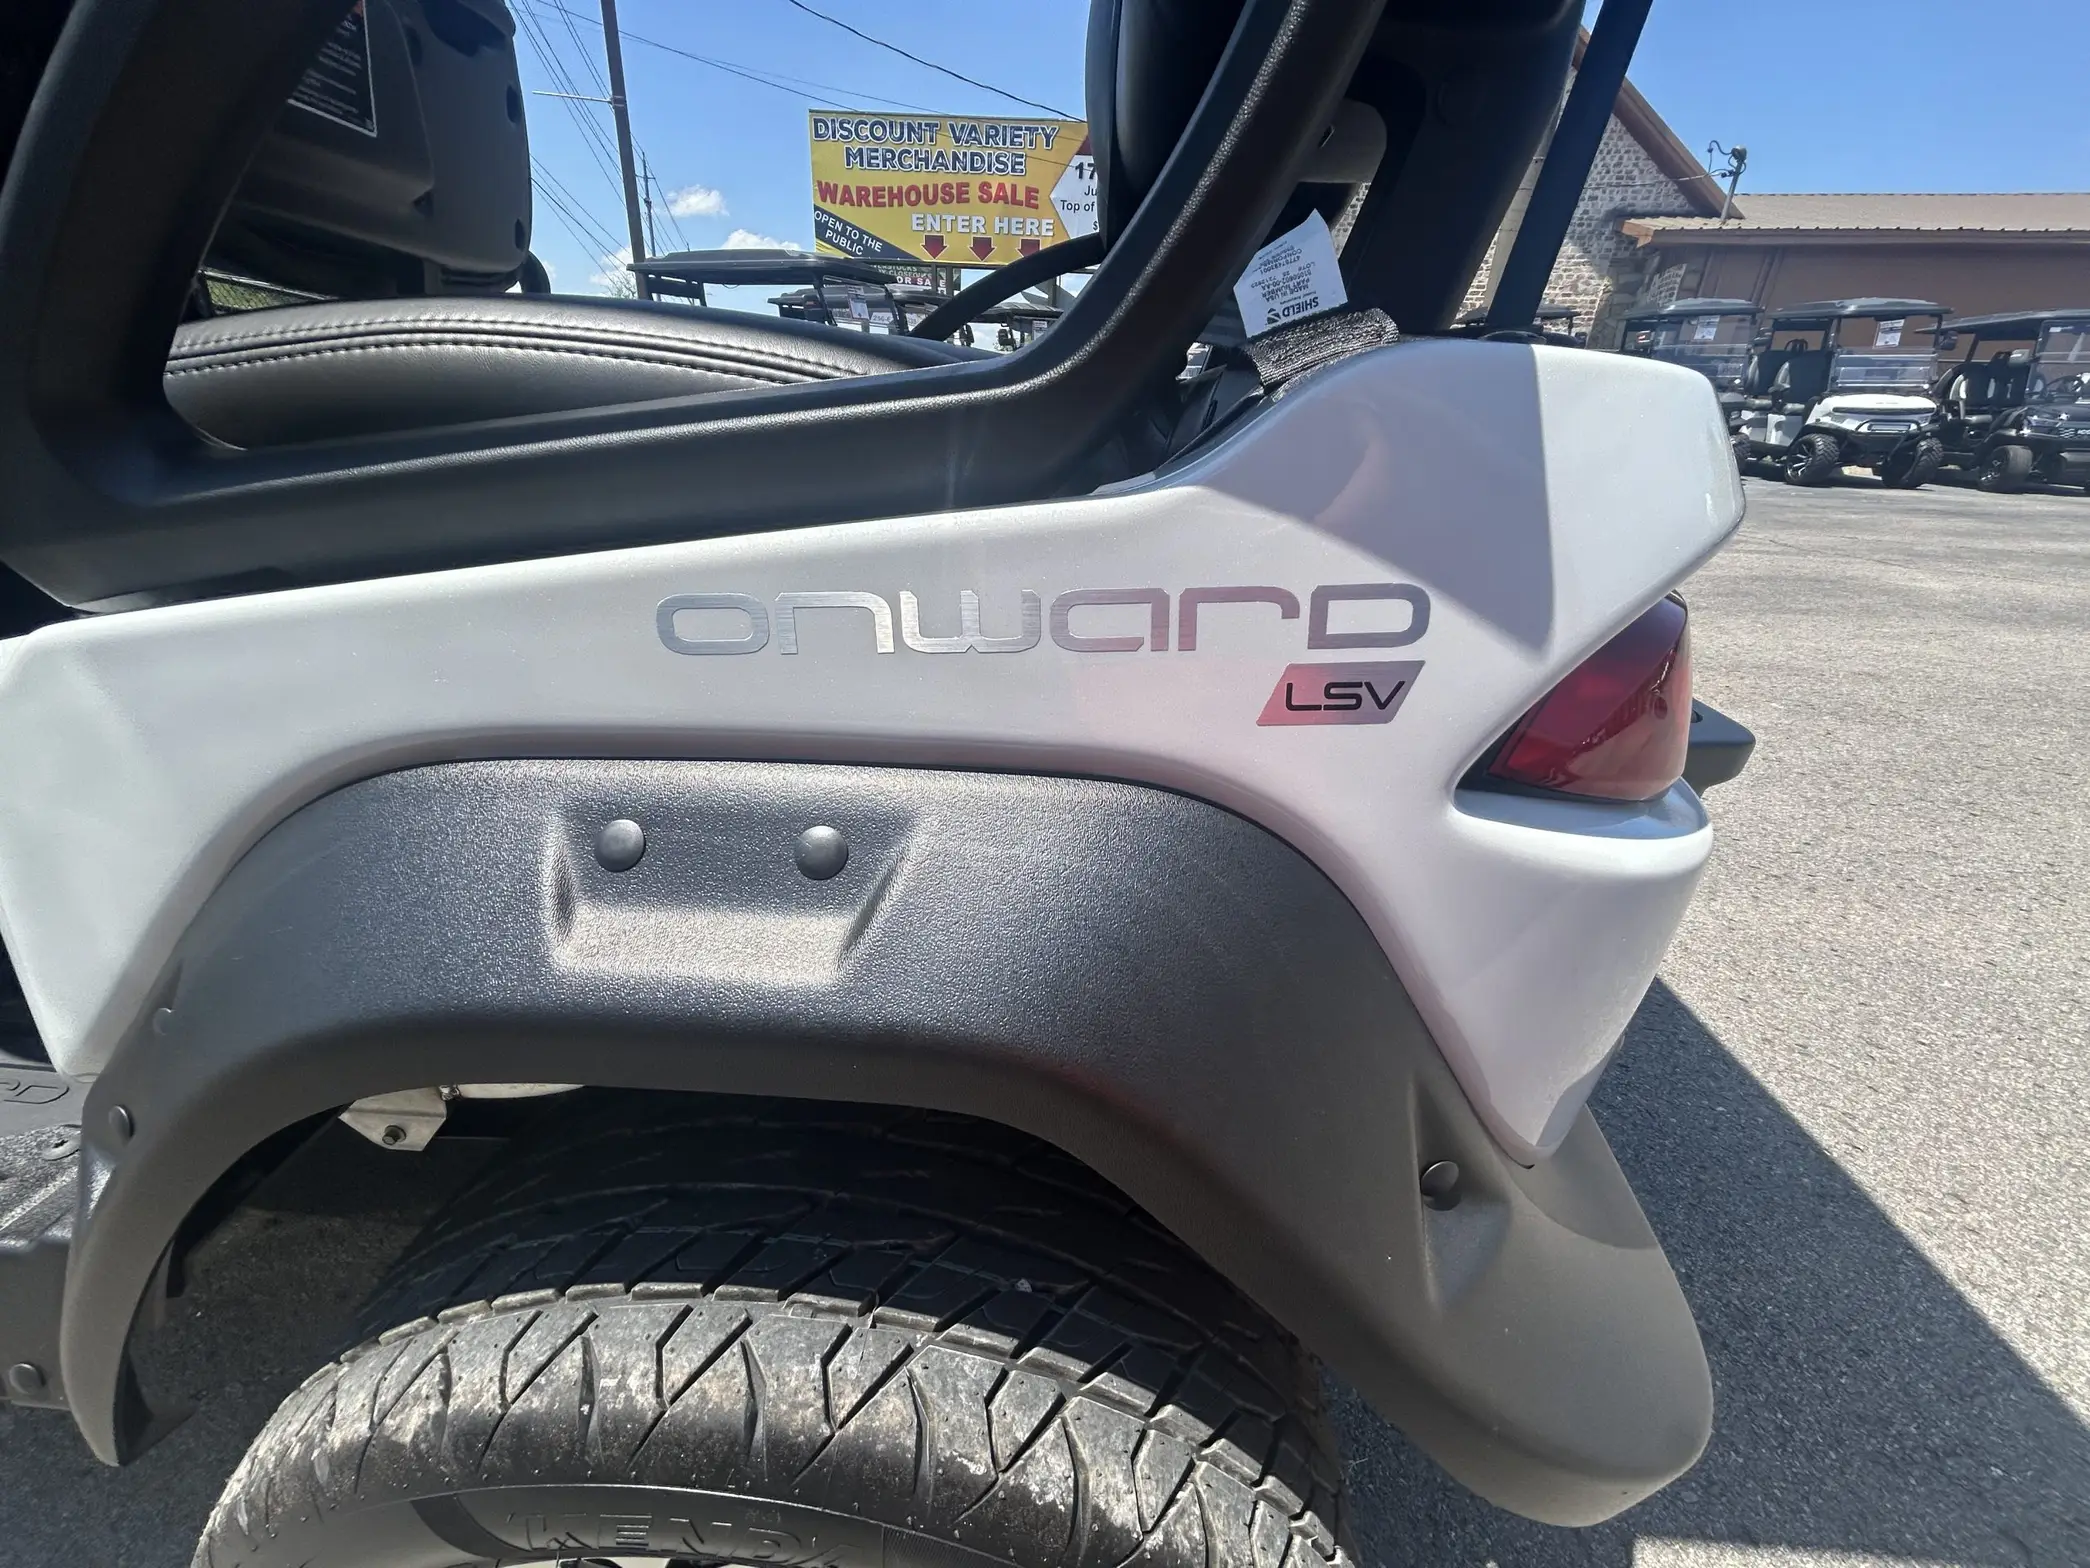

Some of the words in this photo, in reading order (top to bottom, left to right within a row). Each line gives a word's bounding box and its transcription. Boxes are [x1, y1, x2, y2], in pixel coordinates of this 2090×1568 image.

[812, 117, 940, 145] DISCOUNT
[947, 121, 1059, 150] VARIETY
[843, 145, 1027, 175] MERCHANDISE
[816, 179, 970, 208] WAREHOUSE
[978, 181, 1040, 209] SALE
[1060, 199, 1080, 213] Top
[1083, 201, 1096, 213] of
[814, 210, 843, 232] OPEN
[846, 225, 860, 240] TO
[862, 233, 883, 253] THE
[911, 213, 986, 235] ENTER
[994, 216, 1055, 236] HERE
[825, 229, 864, 256] PUBLIC
[1281, 296, 1319, 318] SHIELD
[1286, 681, 1407, 713] LSV
